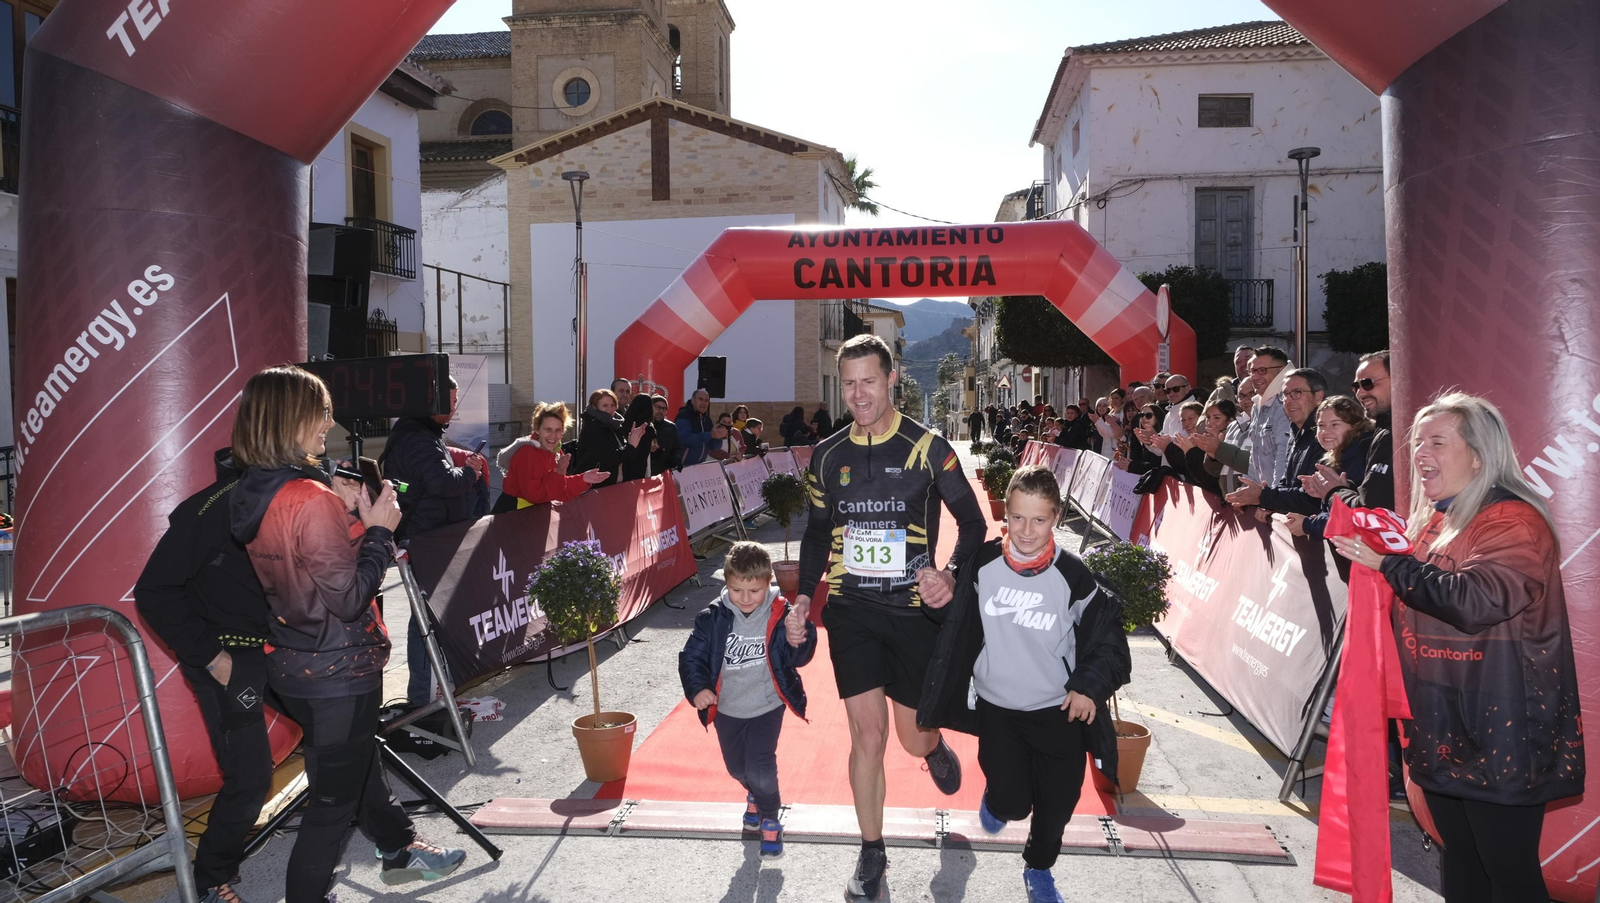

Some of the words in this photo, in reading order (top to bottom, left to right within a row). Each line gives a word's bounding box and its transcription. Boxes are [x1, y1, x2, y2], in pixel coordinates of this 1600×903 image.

[787, 226, 1004, 248] AYUNTAMIENTO
[793, 255, 997, 289] CANTORIA
[687, 489, 728, 515] CANTORIA
[838, 496, 906, 514] Cantoria
[848, 519, 897, 530] Runners
[641, 525, 679, 560] TEAMERGY
[853, 544, 892, 565] 313
[1176, 559, 1220, 603] TEAMERGY
[993, 586, 1044, 608] JUMP
[1012, 608, 1058, 631] MAN
[1231, 595, 1307, 657] TEAMERGY
[1420, 645, 1483, 661] Cantoria
